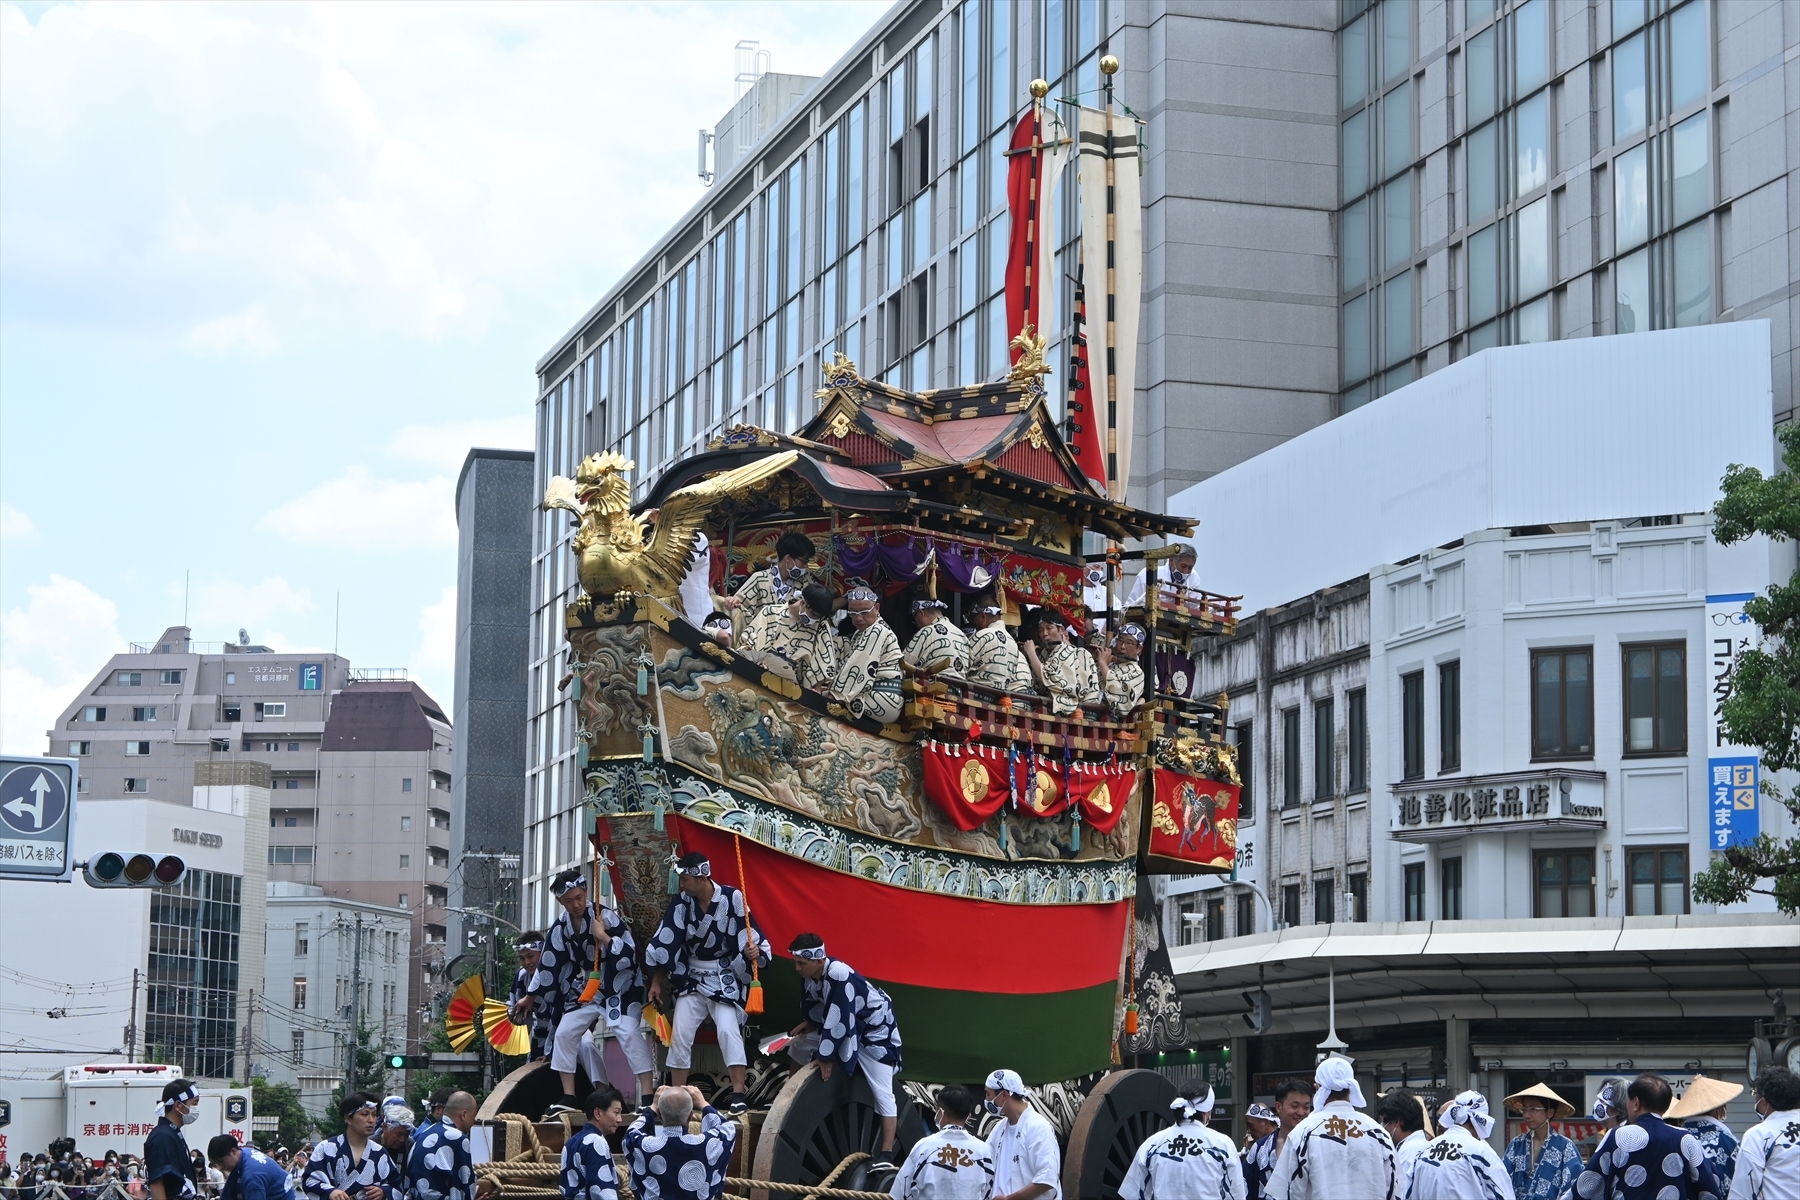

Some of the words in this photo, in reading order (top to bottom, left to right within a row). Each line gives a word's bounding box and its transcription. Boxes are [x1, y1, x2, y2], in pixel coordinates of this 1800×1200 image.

[254, 674, 289, 682] 京都河原町
[1398, 784, 1550, 826] 池善化粧品店
[1713, 765, 1732, 847] 買えます
[1735, 767, 1752, 808] すぐ
